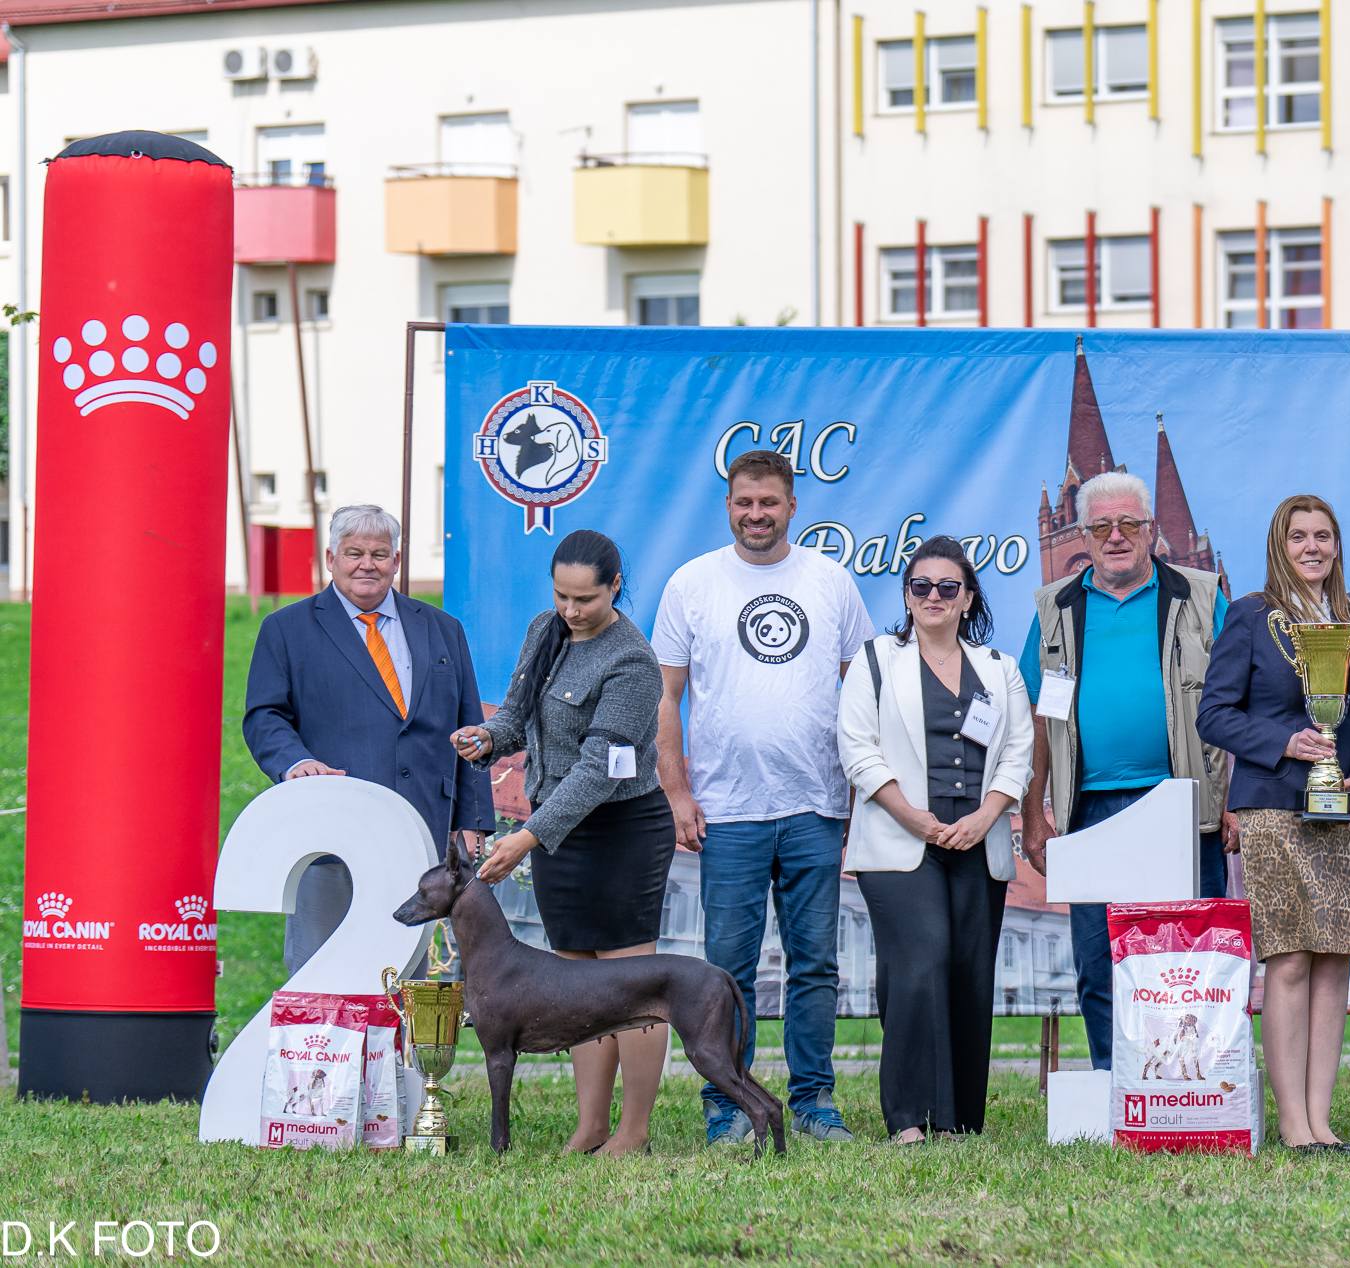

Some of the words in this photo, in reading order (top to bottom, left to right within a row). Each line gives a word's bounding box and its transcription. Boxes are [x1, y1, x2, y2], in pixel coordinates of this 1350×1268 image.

[532, 385, 550, 403] K
[479, 438, 496, 456] H
[588, 440, 600, 458] S
[713, 419, 857, 482] CAC
[794, 512, 1028, 575] Đakvo
[23, 920, 51, 937] OYAL
[138, 923, 192, 941] ROYAL
[199, 775, 439, 1145] 2
[1133, 988, 1178, 1004] ROYAL
[280, 1048, 312, 1061] ROYAL
[1128, 1101, 1143, 1121] M
[1149, 1091, 1223, 1107] medium
[1150, 1113, 1183, 1125] adult
[270, 1126, 282, 1142] M
[286, 1123, 338, 1135] medium
